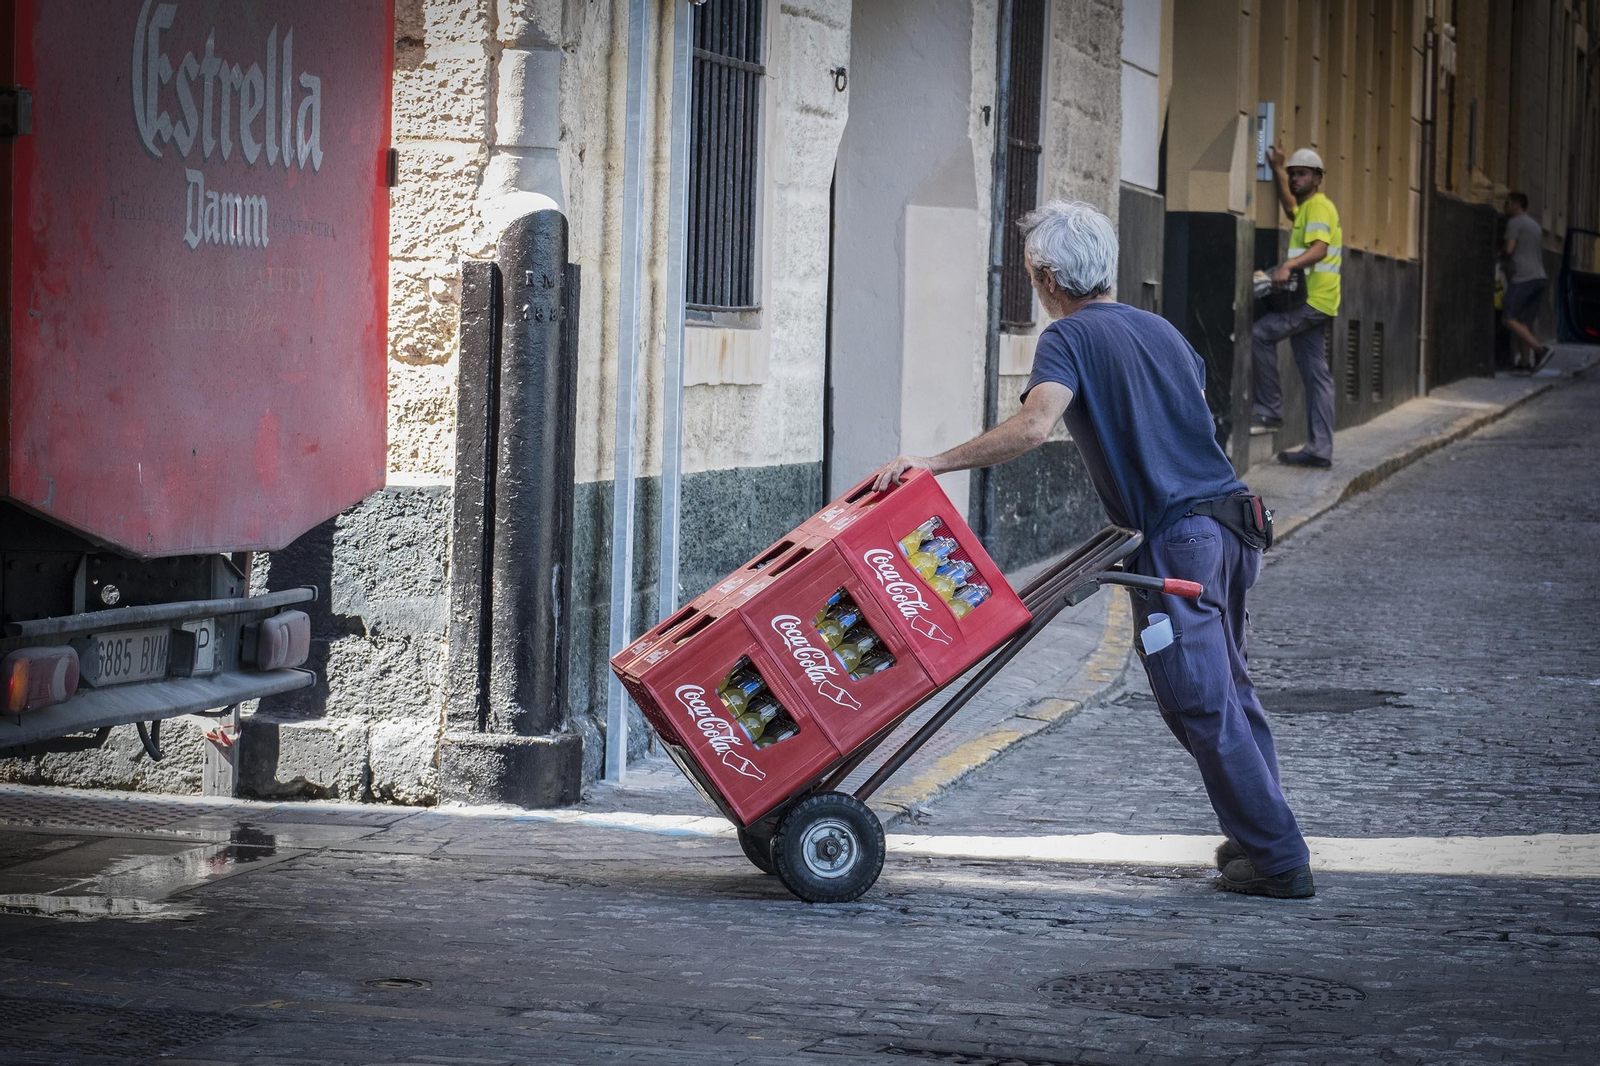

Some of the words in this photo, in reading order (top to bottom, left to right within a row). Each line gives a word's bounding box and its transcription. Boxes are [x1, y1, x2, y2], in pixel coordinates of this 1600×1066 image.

[132, 0, 323, 172] Estrella
[183, 166, 269, 250] Damm
[863, 548, 932, 619] Coca-Cola
[194, 626, 210, 664] P
[771, 614, 840, 684] Coca-Cola
[675, 684, 744, 755] Coca-Cola
